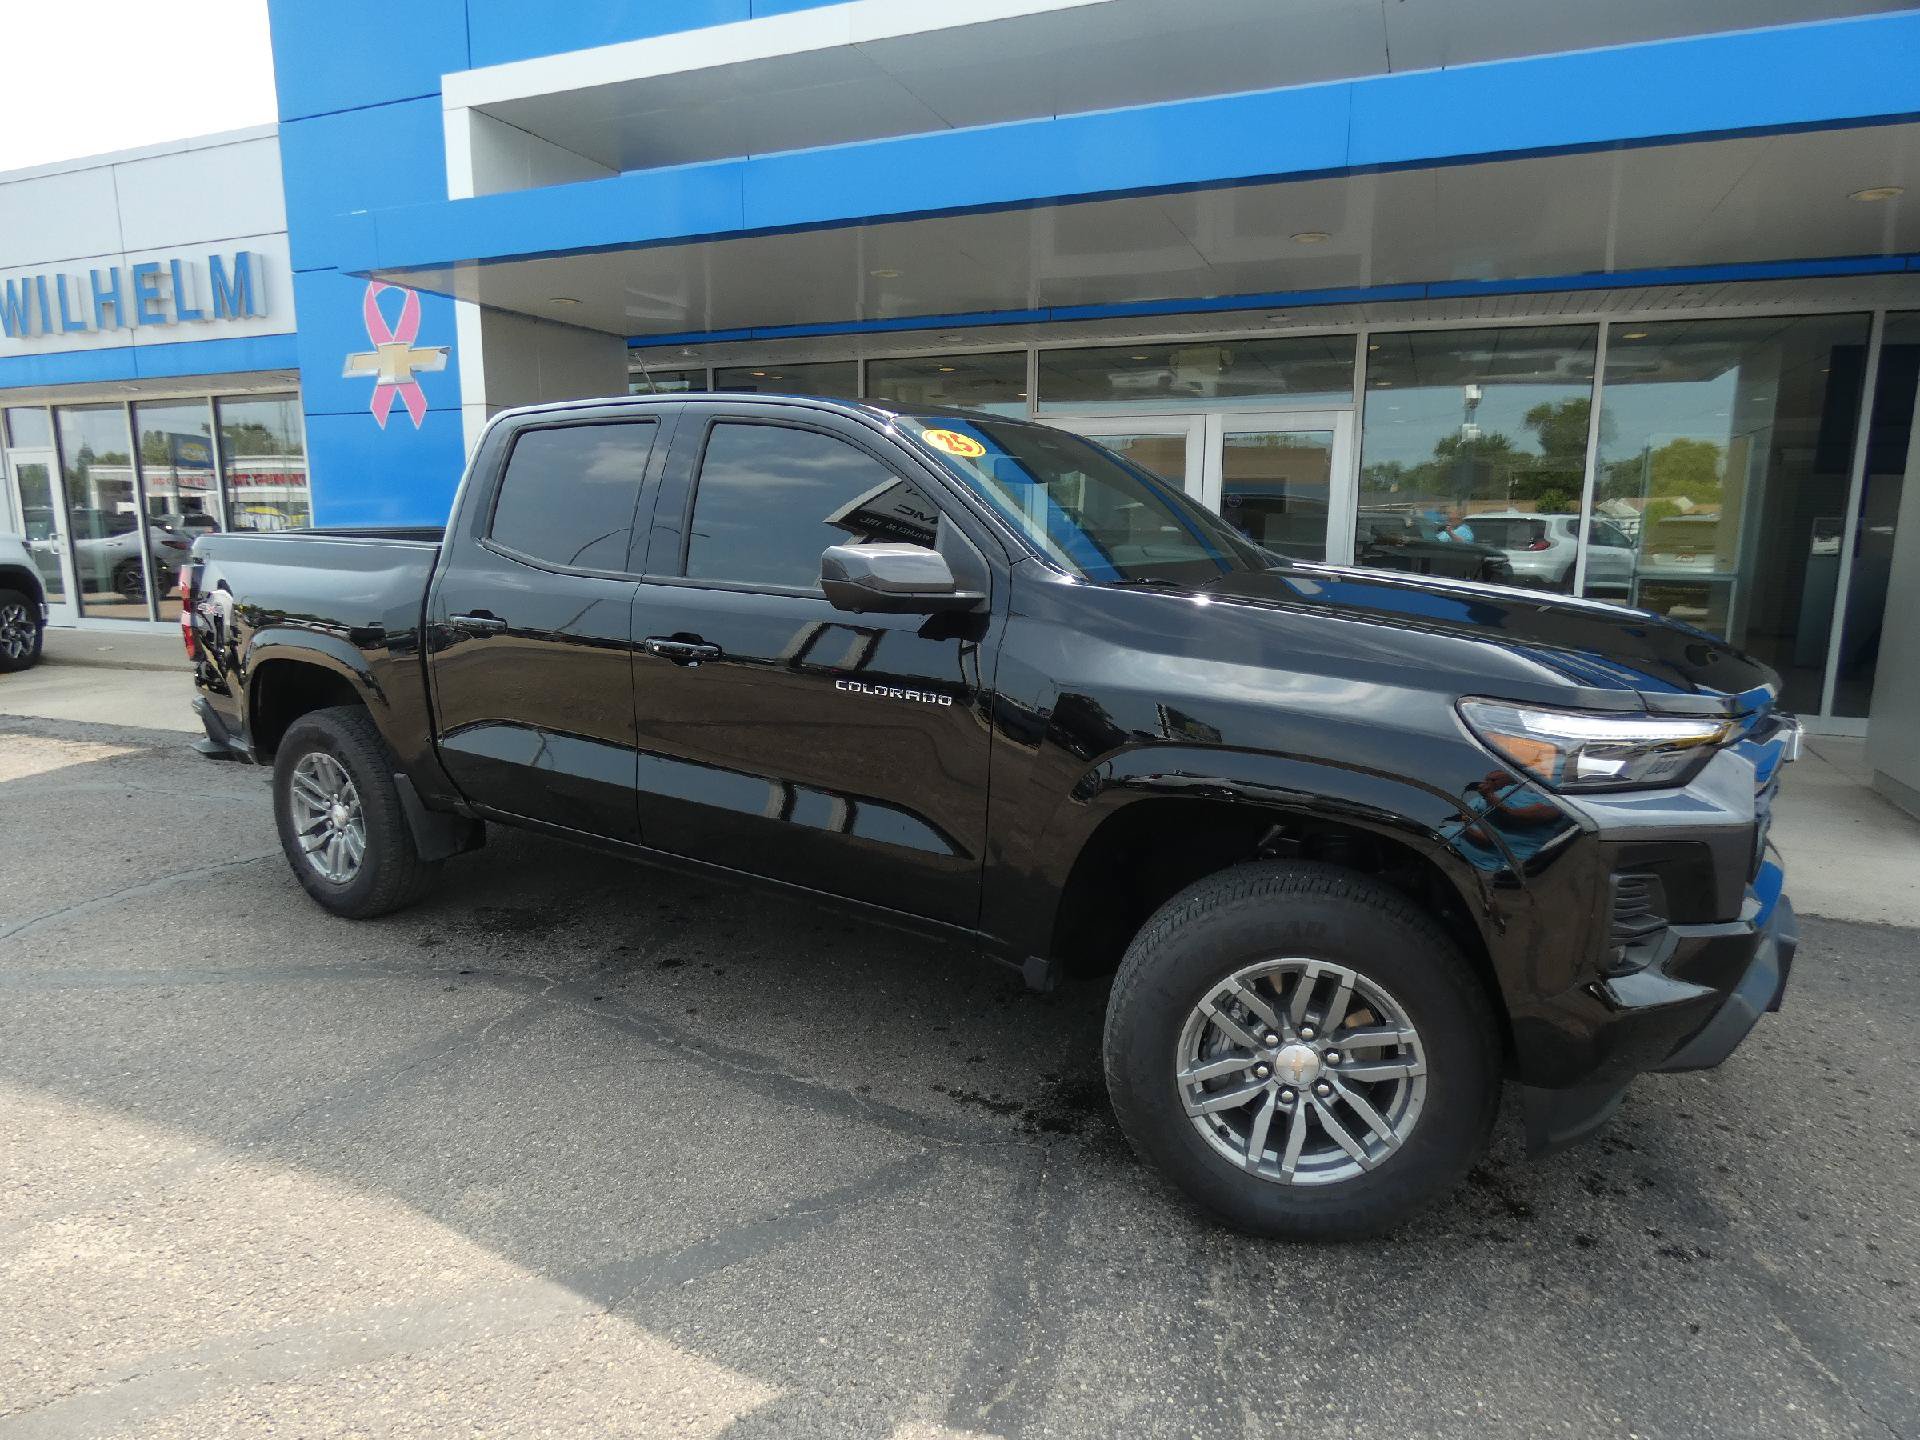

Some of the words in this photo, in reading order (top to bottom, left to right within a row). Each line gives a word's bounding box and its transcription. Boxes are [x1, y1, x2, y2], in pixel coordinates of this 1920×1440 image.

[0, 251, 259, 338] WILHELM
[936, 433, 973, 452] 25
[835, 679, 952, 707] COLORADO
